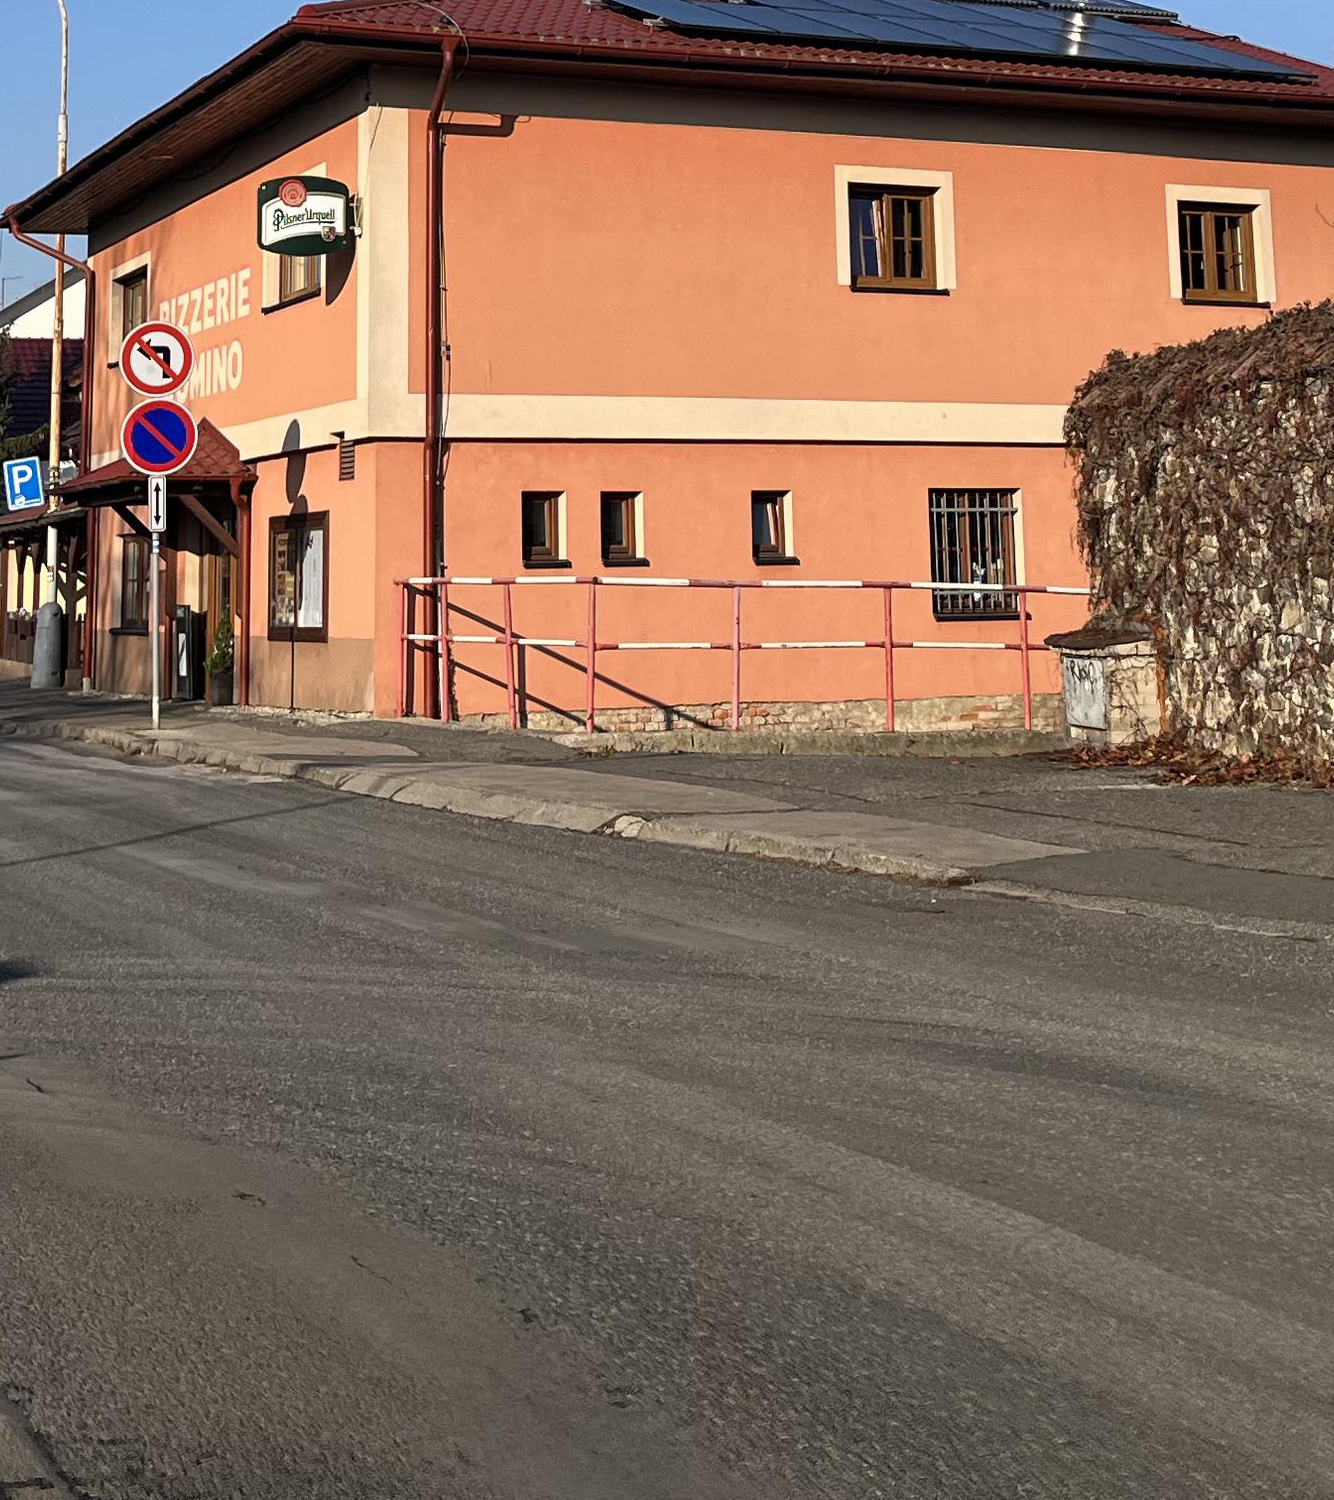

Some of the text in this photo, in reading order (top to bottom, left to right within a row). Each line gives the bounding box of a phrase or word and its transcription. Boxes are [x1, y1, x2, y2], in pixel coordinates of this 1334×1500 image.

[273, 207, 335, 232] Pilsner Urquell
[169, 340, 243, 404] MINO
[11, 464, 33, 495] P
